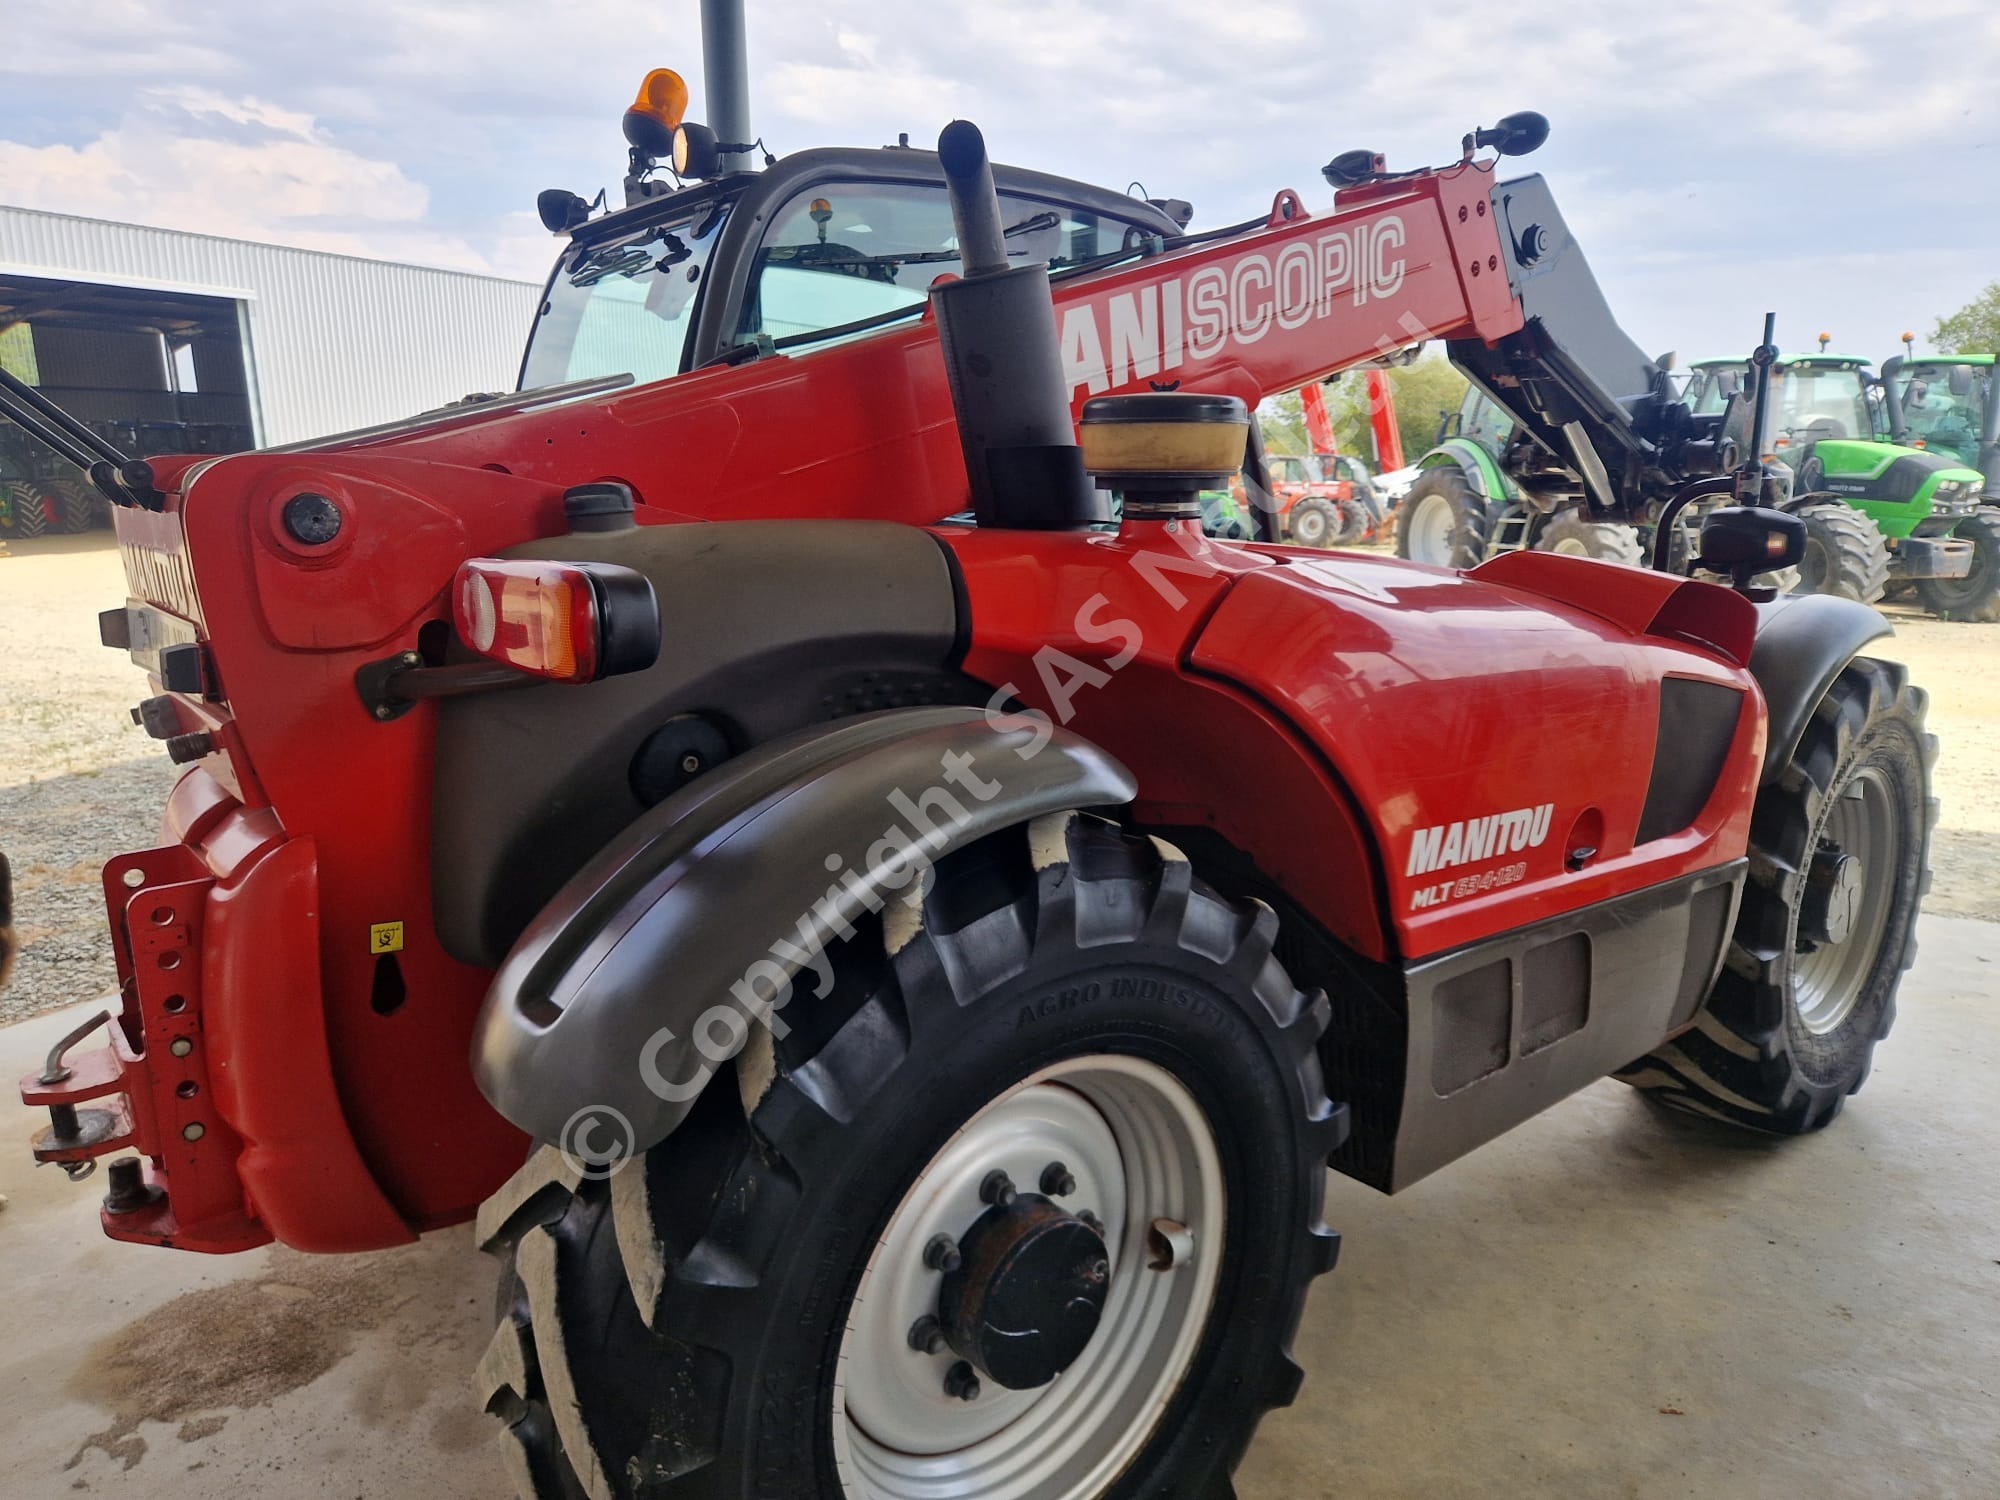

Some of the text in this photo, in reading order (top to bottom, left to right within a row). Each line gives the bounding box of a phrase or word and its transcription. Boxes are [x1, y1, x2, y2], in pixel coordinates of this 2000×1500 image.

[1061, 215, 1405, 403] ANISCOPIC
[1406, 803, 1554, 877] MANITOU
[1410, 881, 1455, 911] MLT
[1016, 981, 1101, 1028] AGRO
